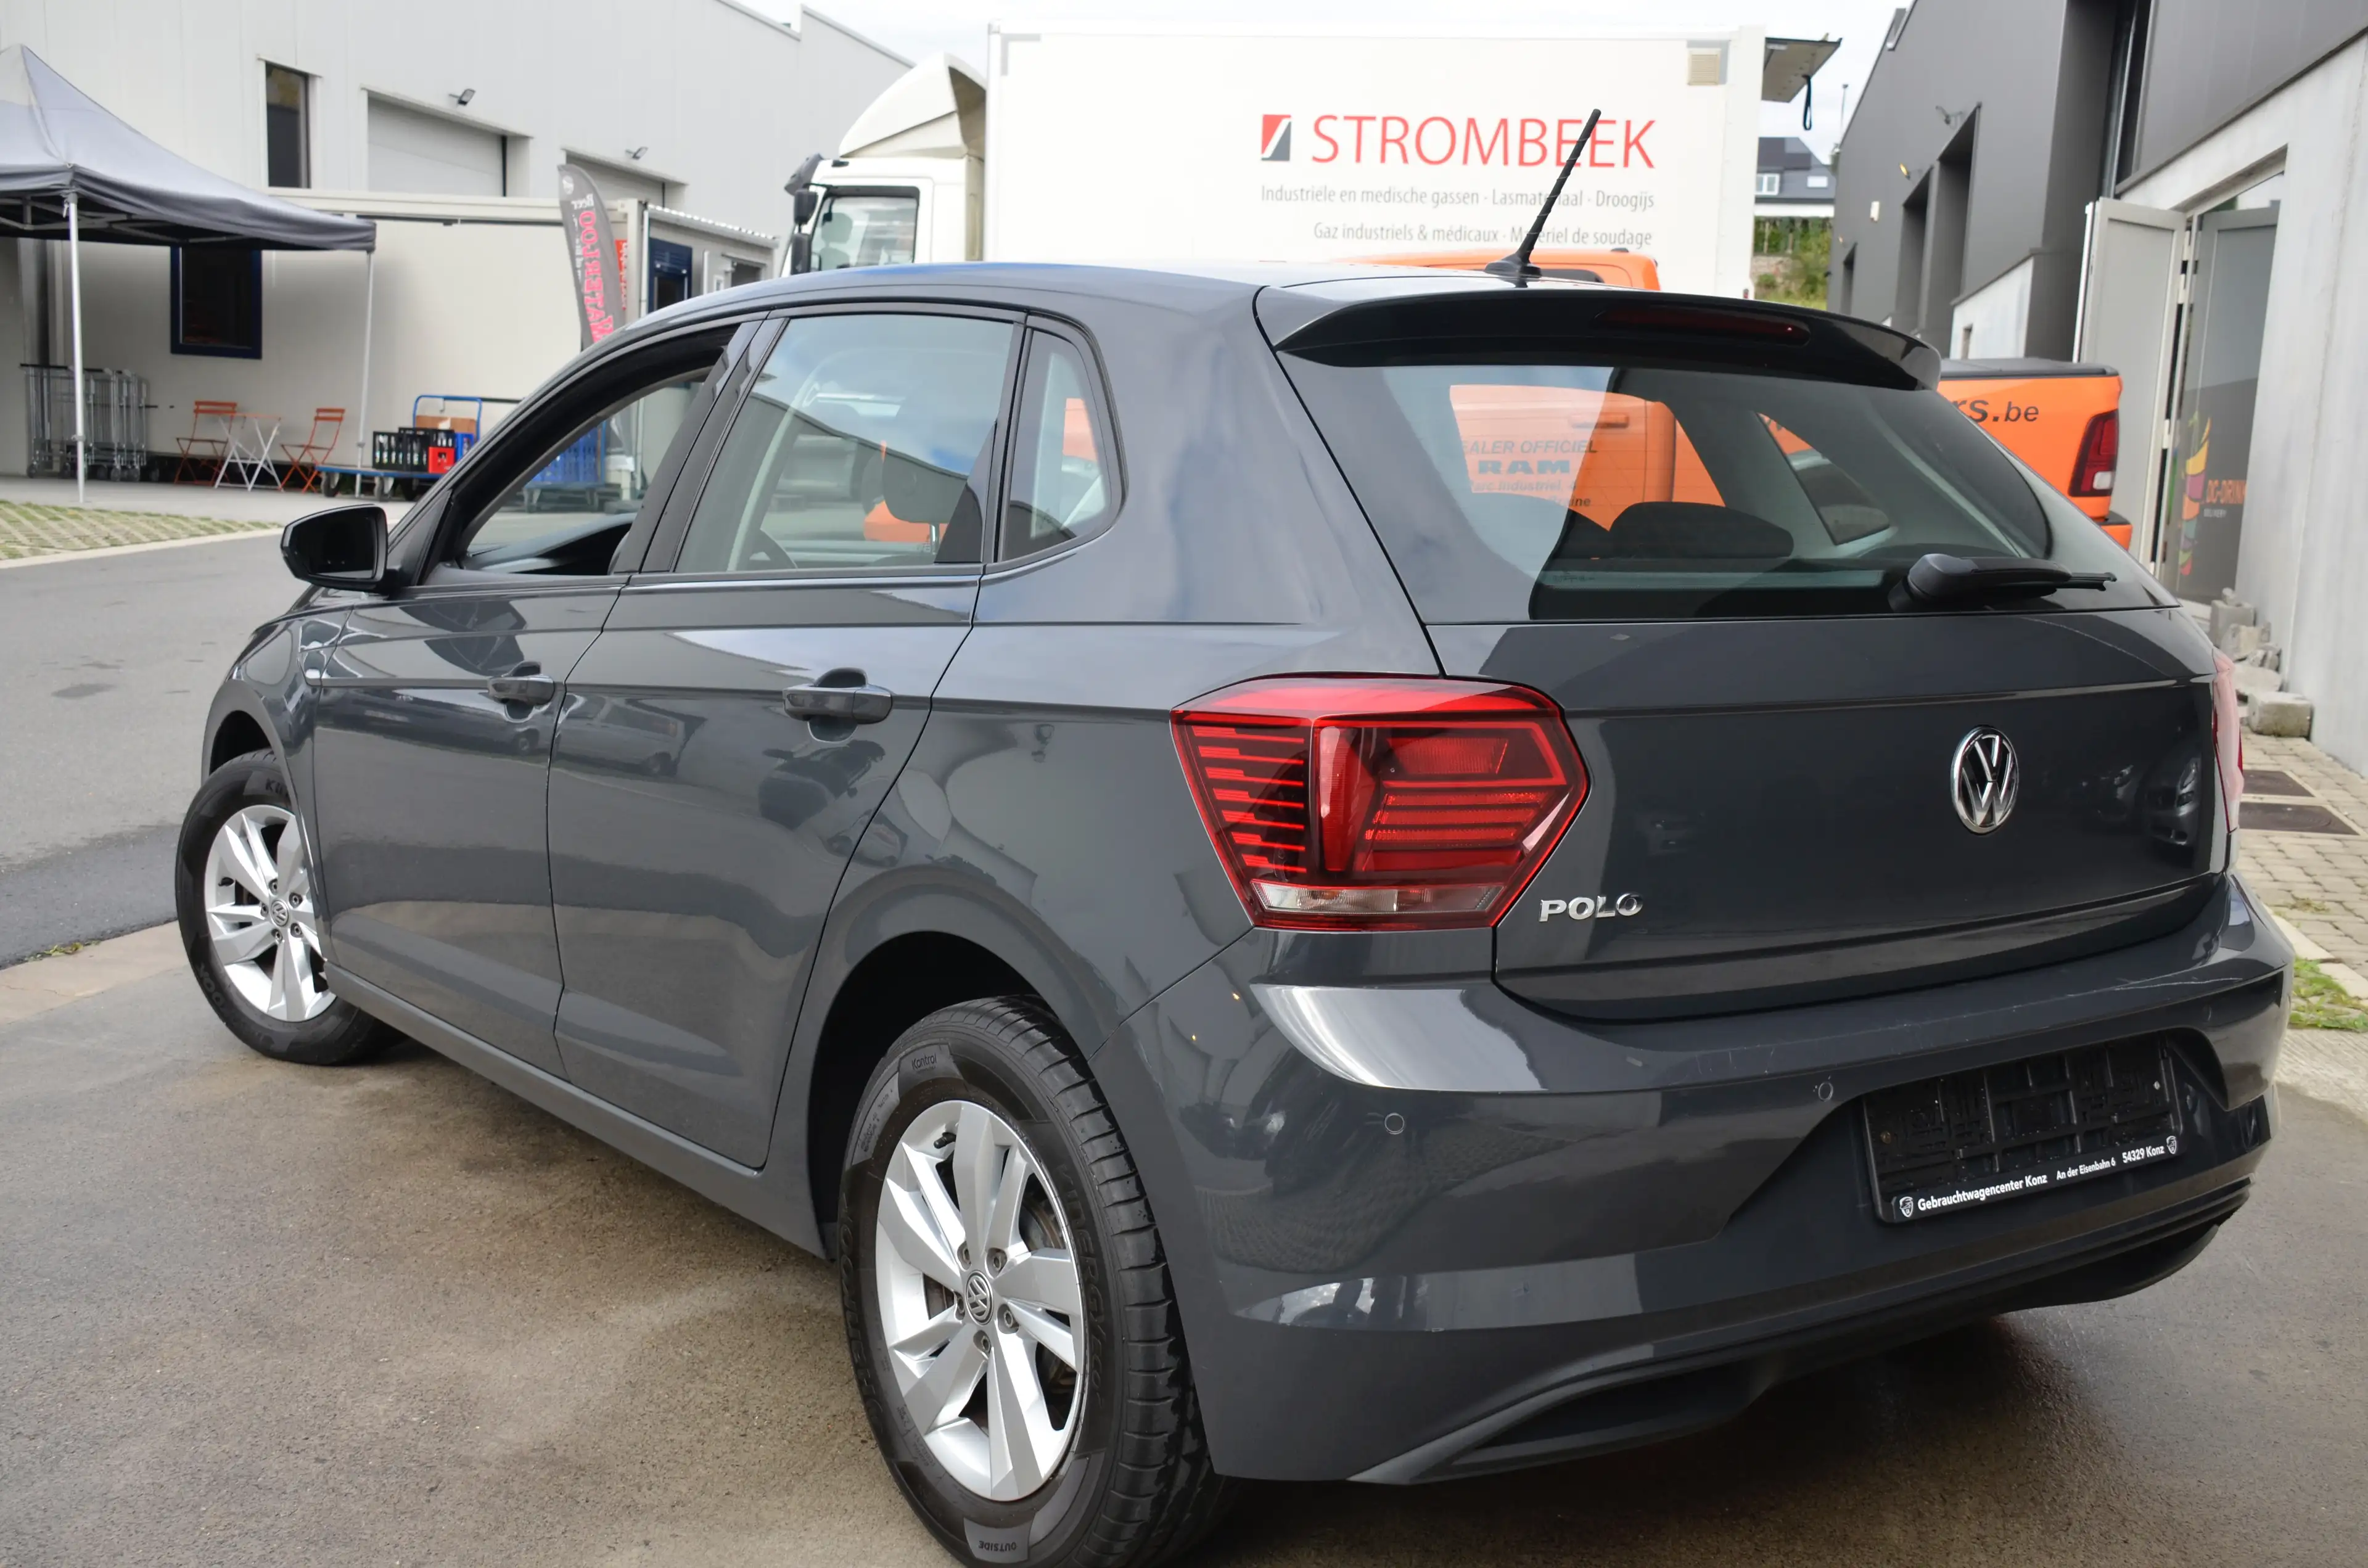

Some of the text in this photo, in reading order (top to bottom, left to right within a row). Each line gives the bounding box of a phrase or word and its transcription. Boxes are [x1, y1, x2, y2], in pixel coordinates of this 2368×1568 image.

[1312, 114, 1656, 168] STROMBEEK
[1339, 189, 1356, 203] en
[1361, 187, 1427, 204] medische
[1431, 192, 1479, 208] gassen
[1596, 190, 1654, 211] Droogijs
[1314, 222, 1338, 239] Gaz
[1342, 223, 1413, 241] industriels
[1417, 224, 1427, 240] &
[1431, 223, 1498, 242] médicaux
[1572, 228, 1589, 244] de
[1593, 228, 1652, 250] soudage
[1520, 439, 1598, 454] OFFICIEL
[1478, 460, 1570, 475] RAM
[1539, 893, 1644, 922] POLO
[1917, 1145, 2166, 1212] Gebrauchtwagencenter Konz An der Eisenbahn 6 54329 Konz
[978, 1540, 1017, 1553] OUTSIDE
